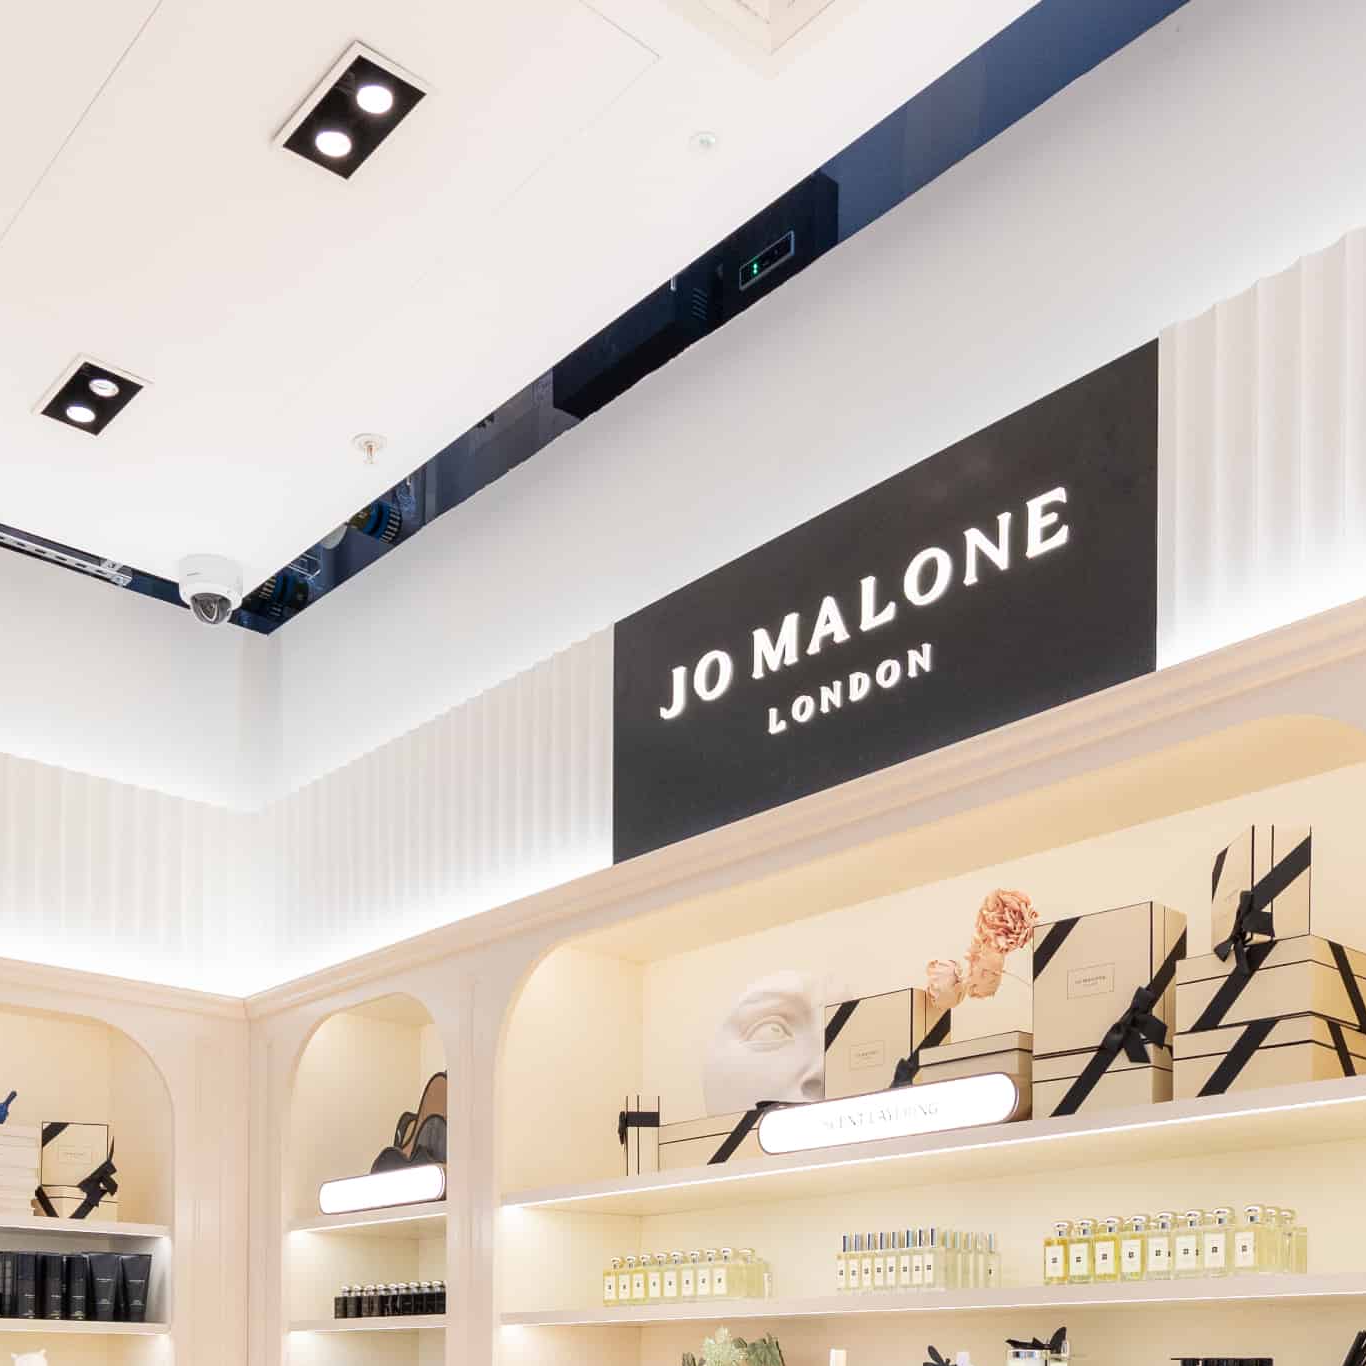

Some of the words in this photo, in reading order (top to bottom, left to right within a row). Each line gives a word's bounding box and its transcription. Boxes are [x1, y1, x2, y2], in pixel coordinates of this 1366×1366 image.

[659, 649, 734, 720] JO
[751, 486, 1069, 680] MALONE
[768, 642, 932, 735] LONDON
